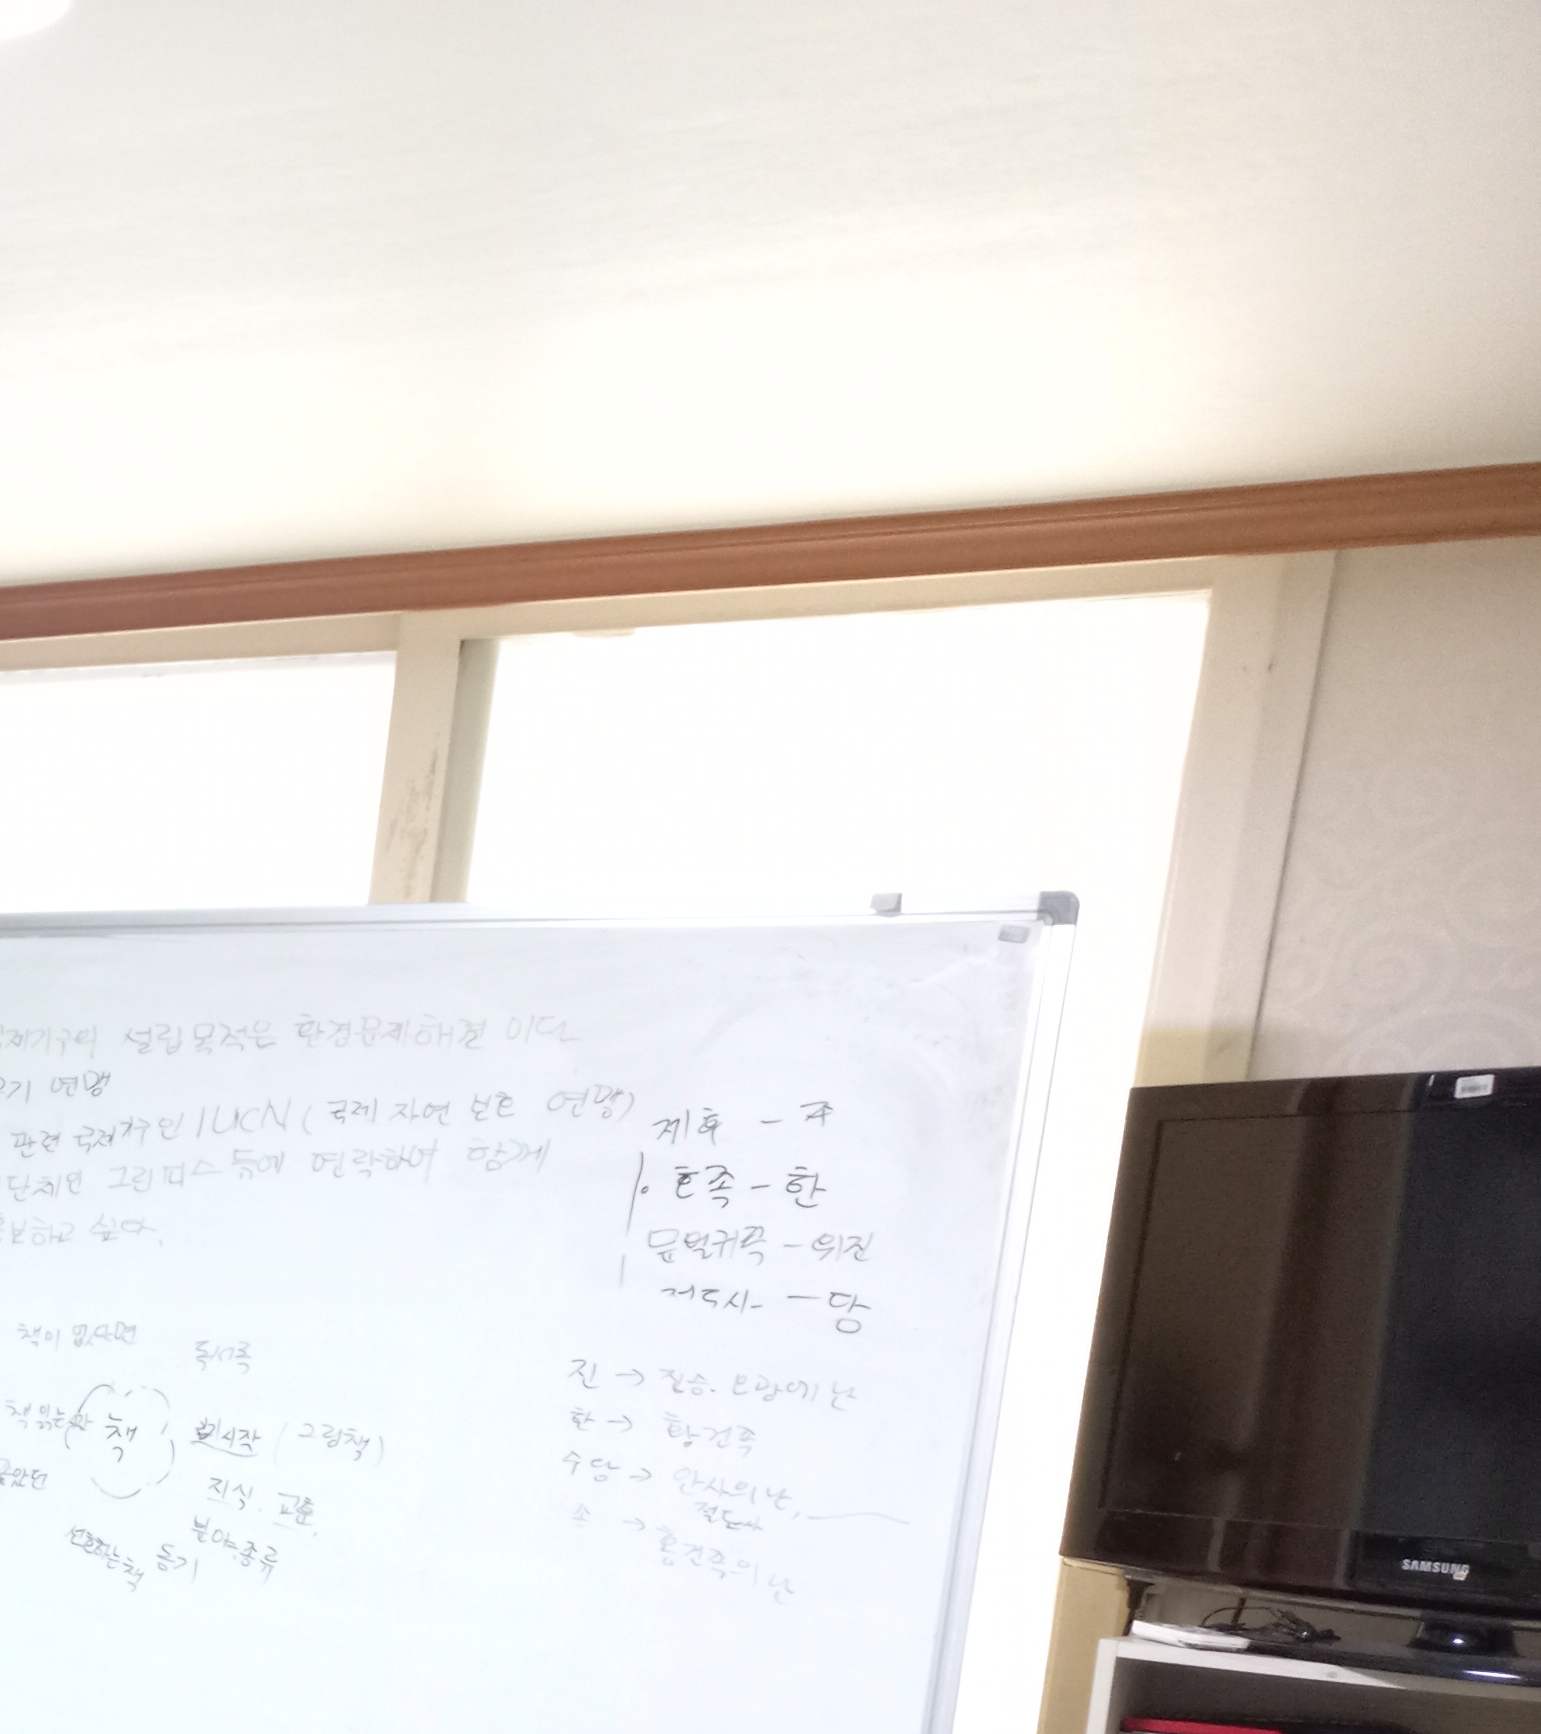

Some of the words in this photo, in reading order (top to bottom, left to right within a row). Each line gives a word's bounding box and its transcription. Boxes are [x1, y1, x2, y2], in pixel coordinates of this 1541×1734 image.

[50, 1070, 112, 1097] 연맹
[13, 1128, 61, 1157] 관련
[785, 1166, 826, 1208] 한
[828, 1291, 872, 1334] 당
[567, 1358, 601, 1390] 진
[831, 1381, 858, 1411] 난
[104, 1411, 138, 1463] 책
[1402, 1559, 1470, 1575] SAMSUNG
